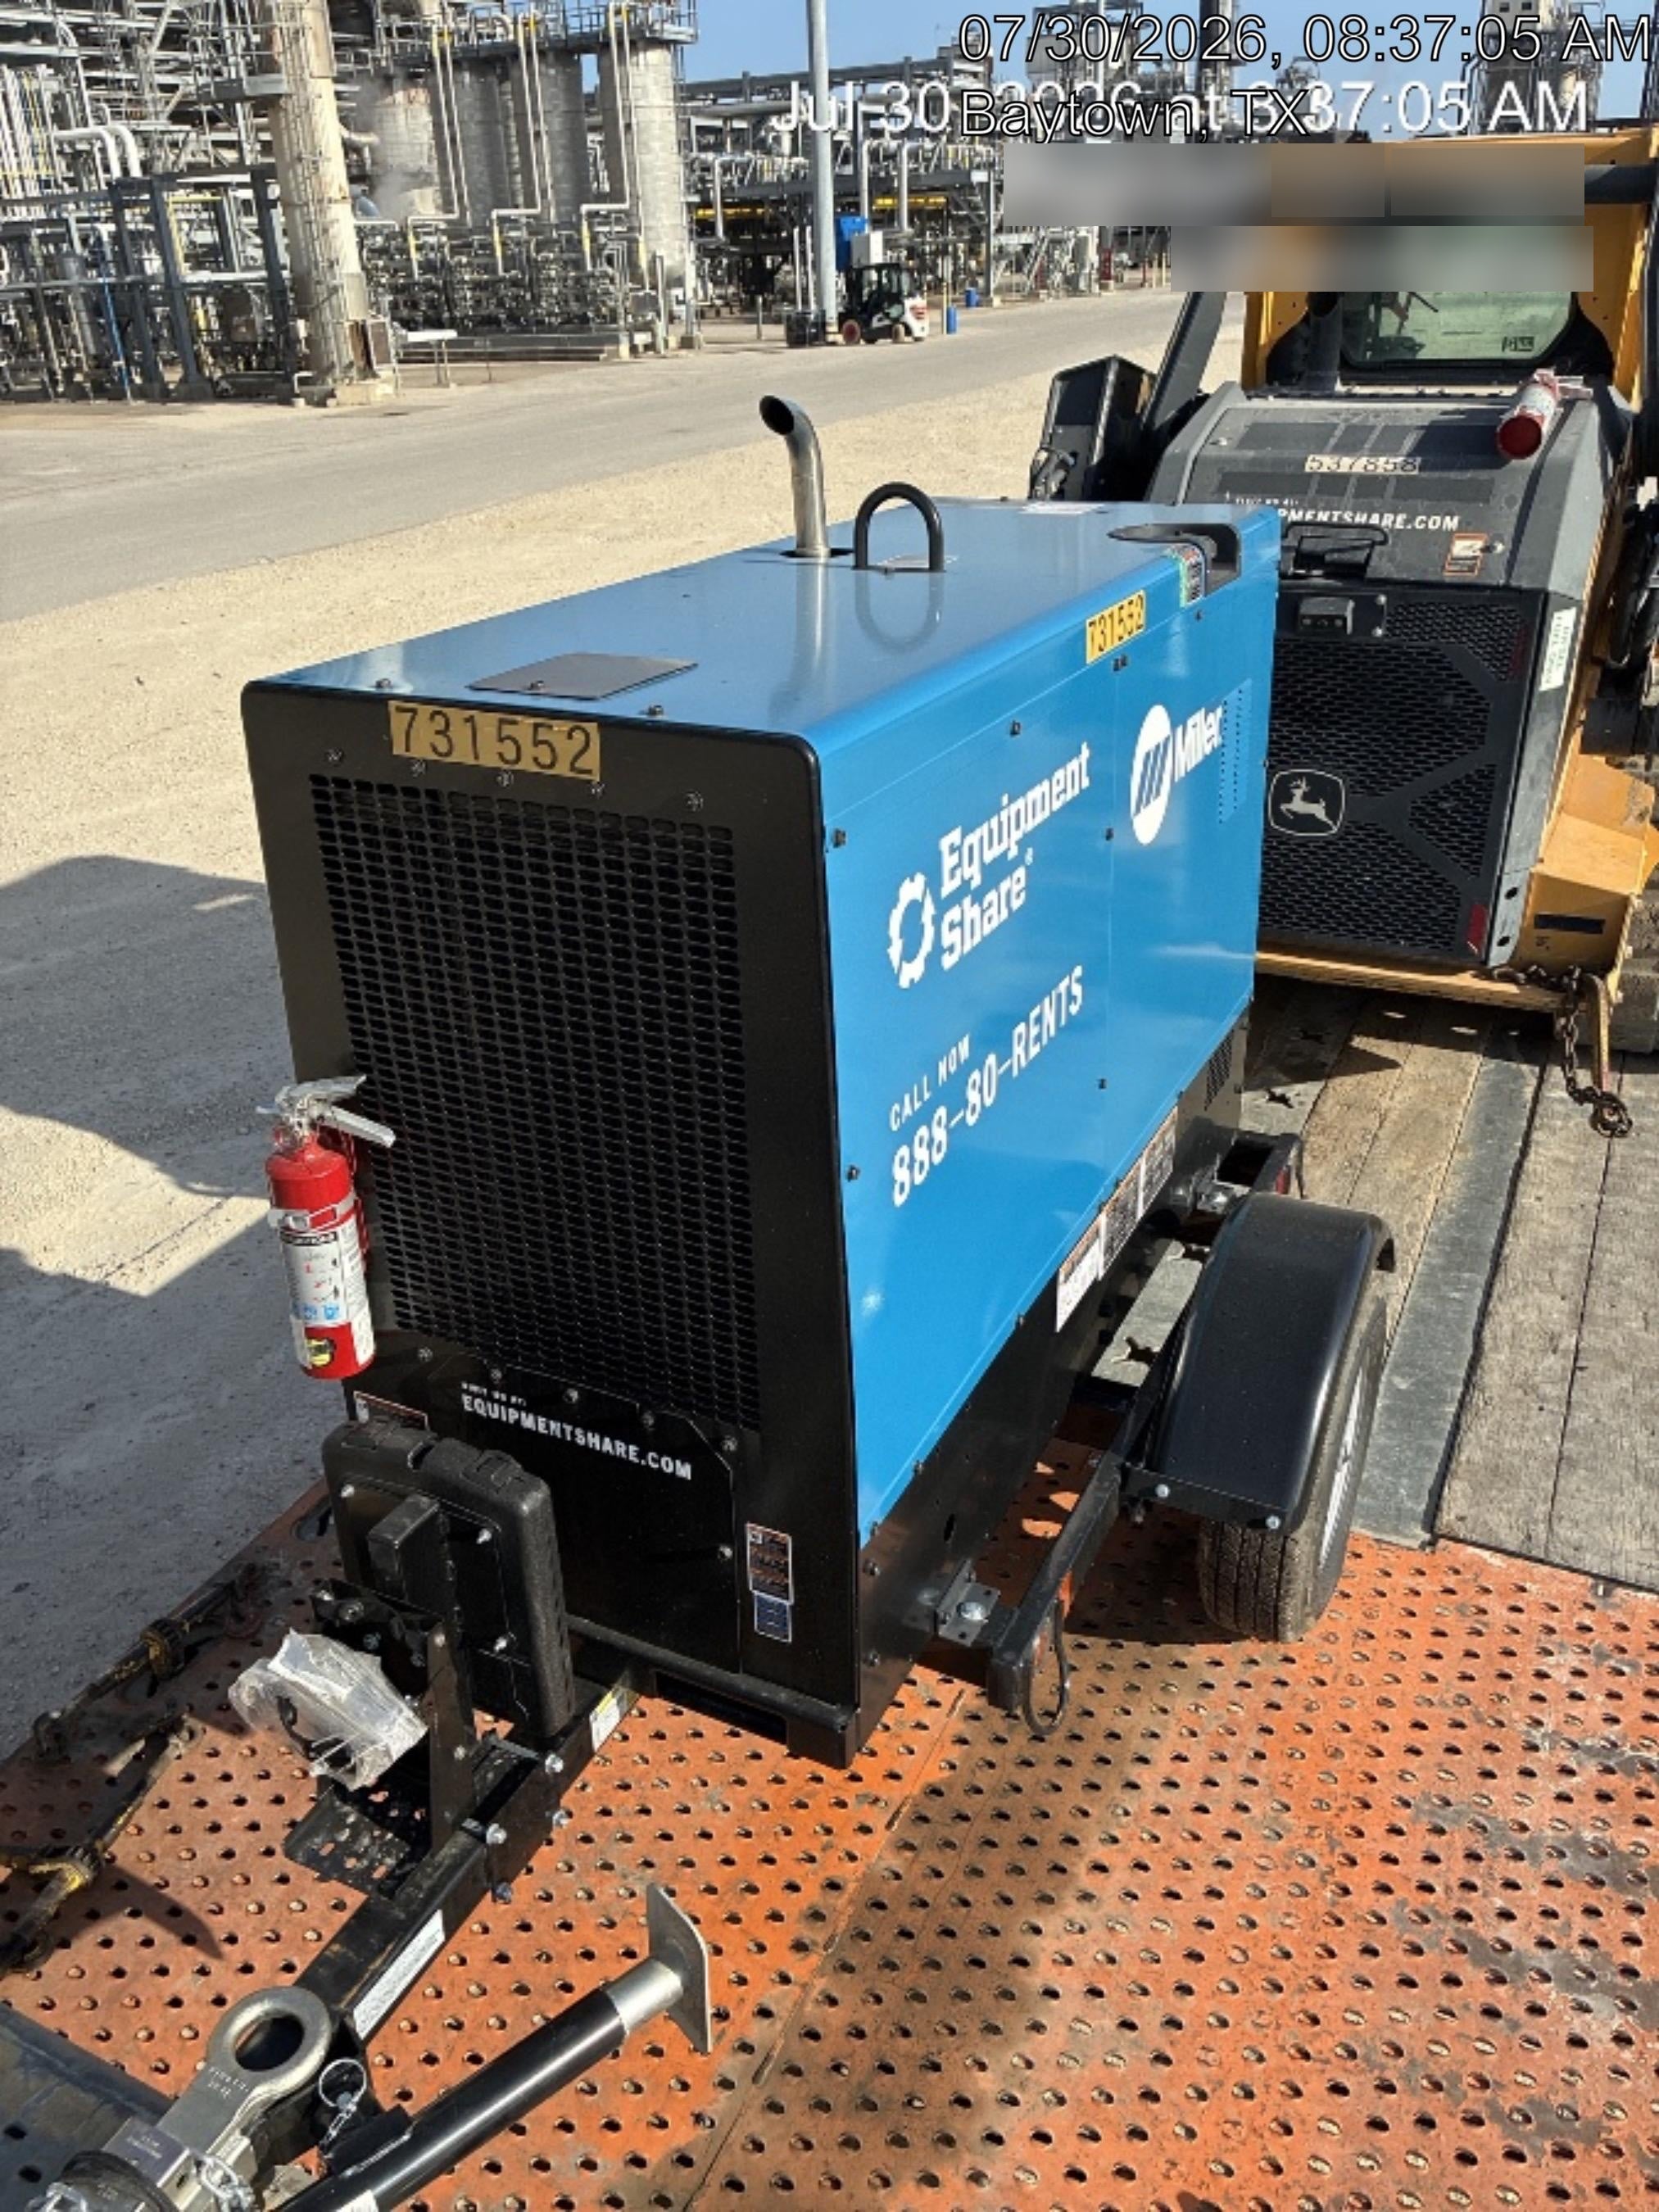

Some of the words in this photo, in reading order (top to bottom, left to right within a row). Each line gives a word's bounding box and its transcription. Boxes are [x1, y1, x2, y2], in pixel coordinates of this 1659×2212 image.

[1308, 456, 1420, 473] 537858
[1276, 507, 1461, 532] PMENTSHARE.COM
[1088, 593, 1145, 661] 731552
[395, 705, 593, 774] 731552
[1174, 704, 1224, 784] Miller
[939, 741, 1090, 900] Equipment
[941, 864, 1027, 971] Share
[890, 1075, 931, 1131] CALL
[938, 1033, 971, 1087] NOW
[891, 964, 1083, 1208] 888-80-RENTS
[460, 1392, 693, 1481] EQUIPMENTSHARE.COM
